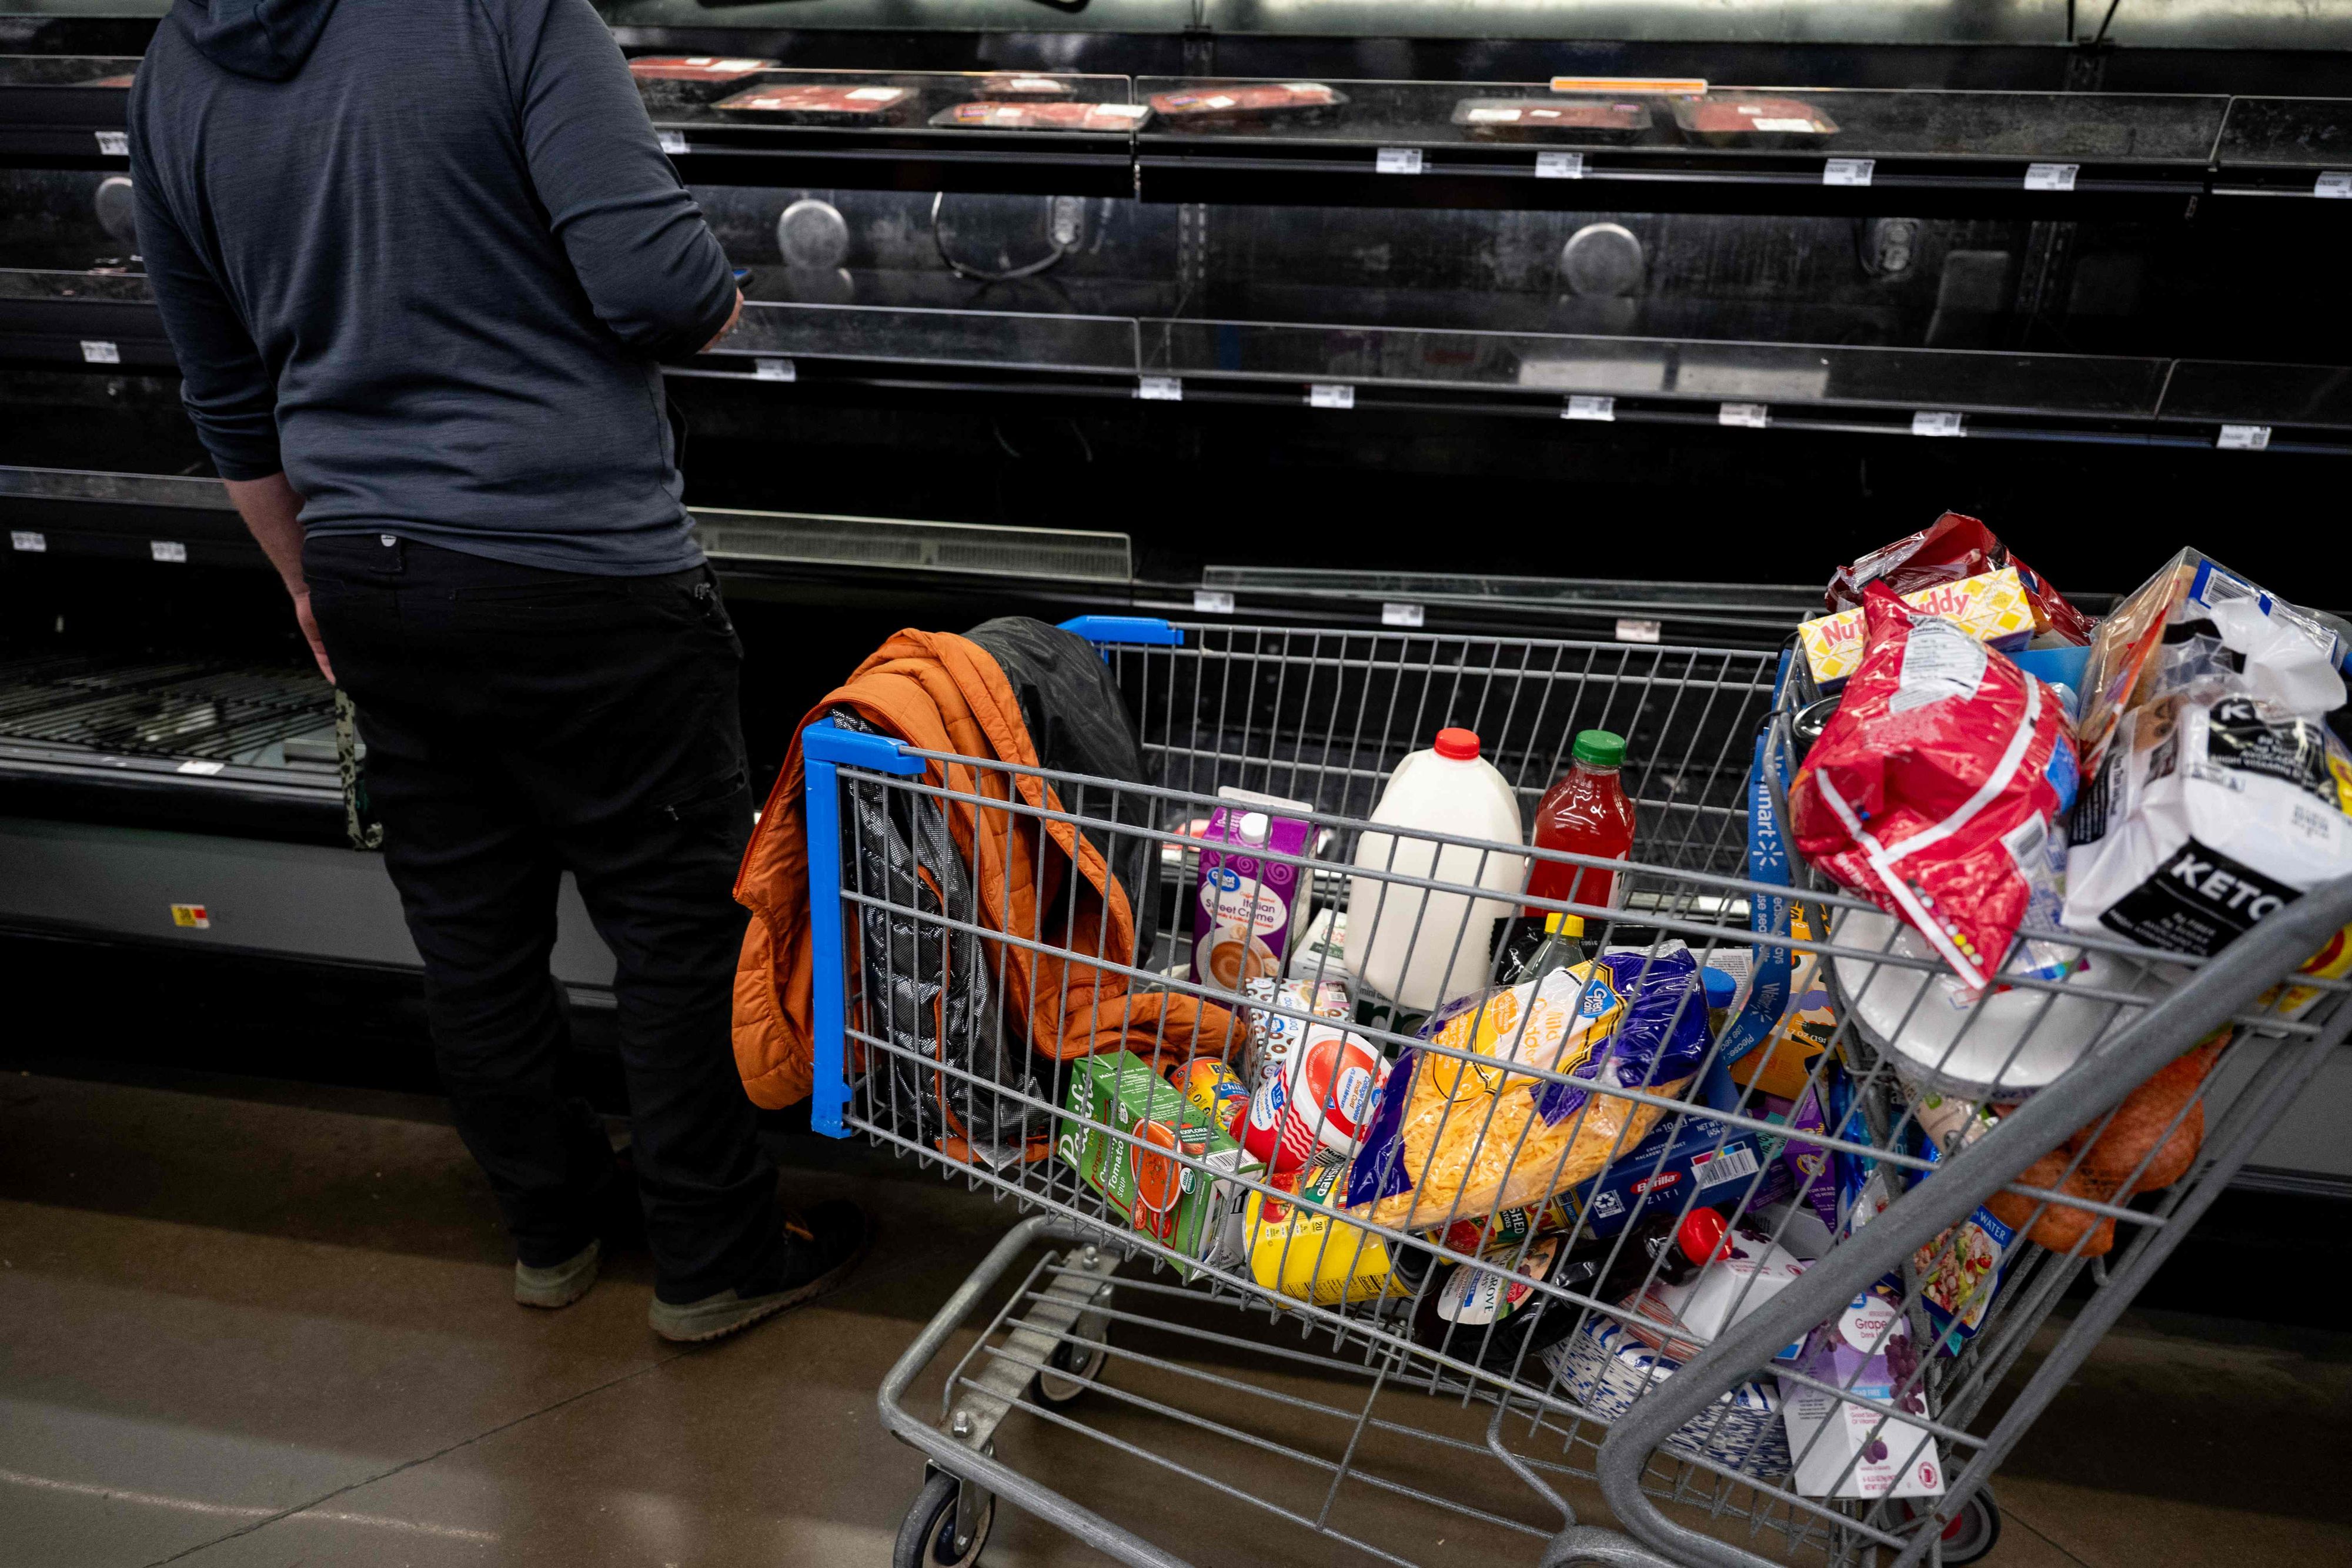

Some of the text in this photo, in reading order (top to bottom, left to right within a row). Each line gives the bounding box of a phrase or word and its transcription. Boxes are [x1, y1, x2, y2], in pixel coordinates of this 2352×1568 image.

[1820, 587, 1970, 648] Nut uddy
[1758, 755, 1784, 837] Wlmart
[1211, 870, 1236, 884] Geat
[2170, 852, 2285, 921] KETO
[1238, 908, 1274, 923] Crme
[1359, 987, 1375, 998] mini
[1591, 988, 1608, 1012] Grea
[1582, 995, 1593, 1014] Valu
[1797, 1029, 1809, 1039] OZ
[1220, 1083, 1245, 1092] Chili
[1349, 1079, 1362, 1109] Small Curd
[1352, 1075, 1371, 1121] Cottage Cheese
[1180, 1127, 1208, 1135] EXPLORE
[1696, 1121, 1709, 1132] NET
[1100, 1136, 1118, 1183] Cry
[1108, 1139, 1124, 1189] Tomato
[1117, 1176, 1127, 1198] SOUP
[1636, 1173, 1678, 1193] Brilla
[1646, 1188, 1679, 1205] ZITI
[1315, 1221, 1324, 1232] 20
[1502, 1210, 1512, 1228] ATOES
[1509, 1207, 1525, 1234] SHED
[1980, 1211, 2006, 1241] WATER
[1484, 1273, 1499, 1314] GROVE
[1855, 1318, 1887, 1332] Grape
